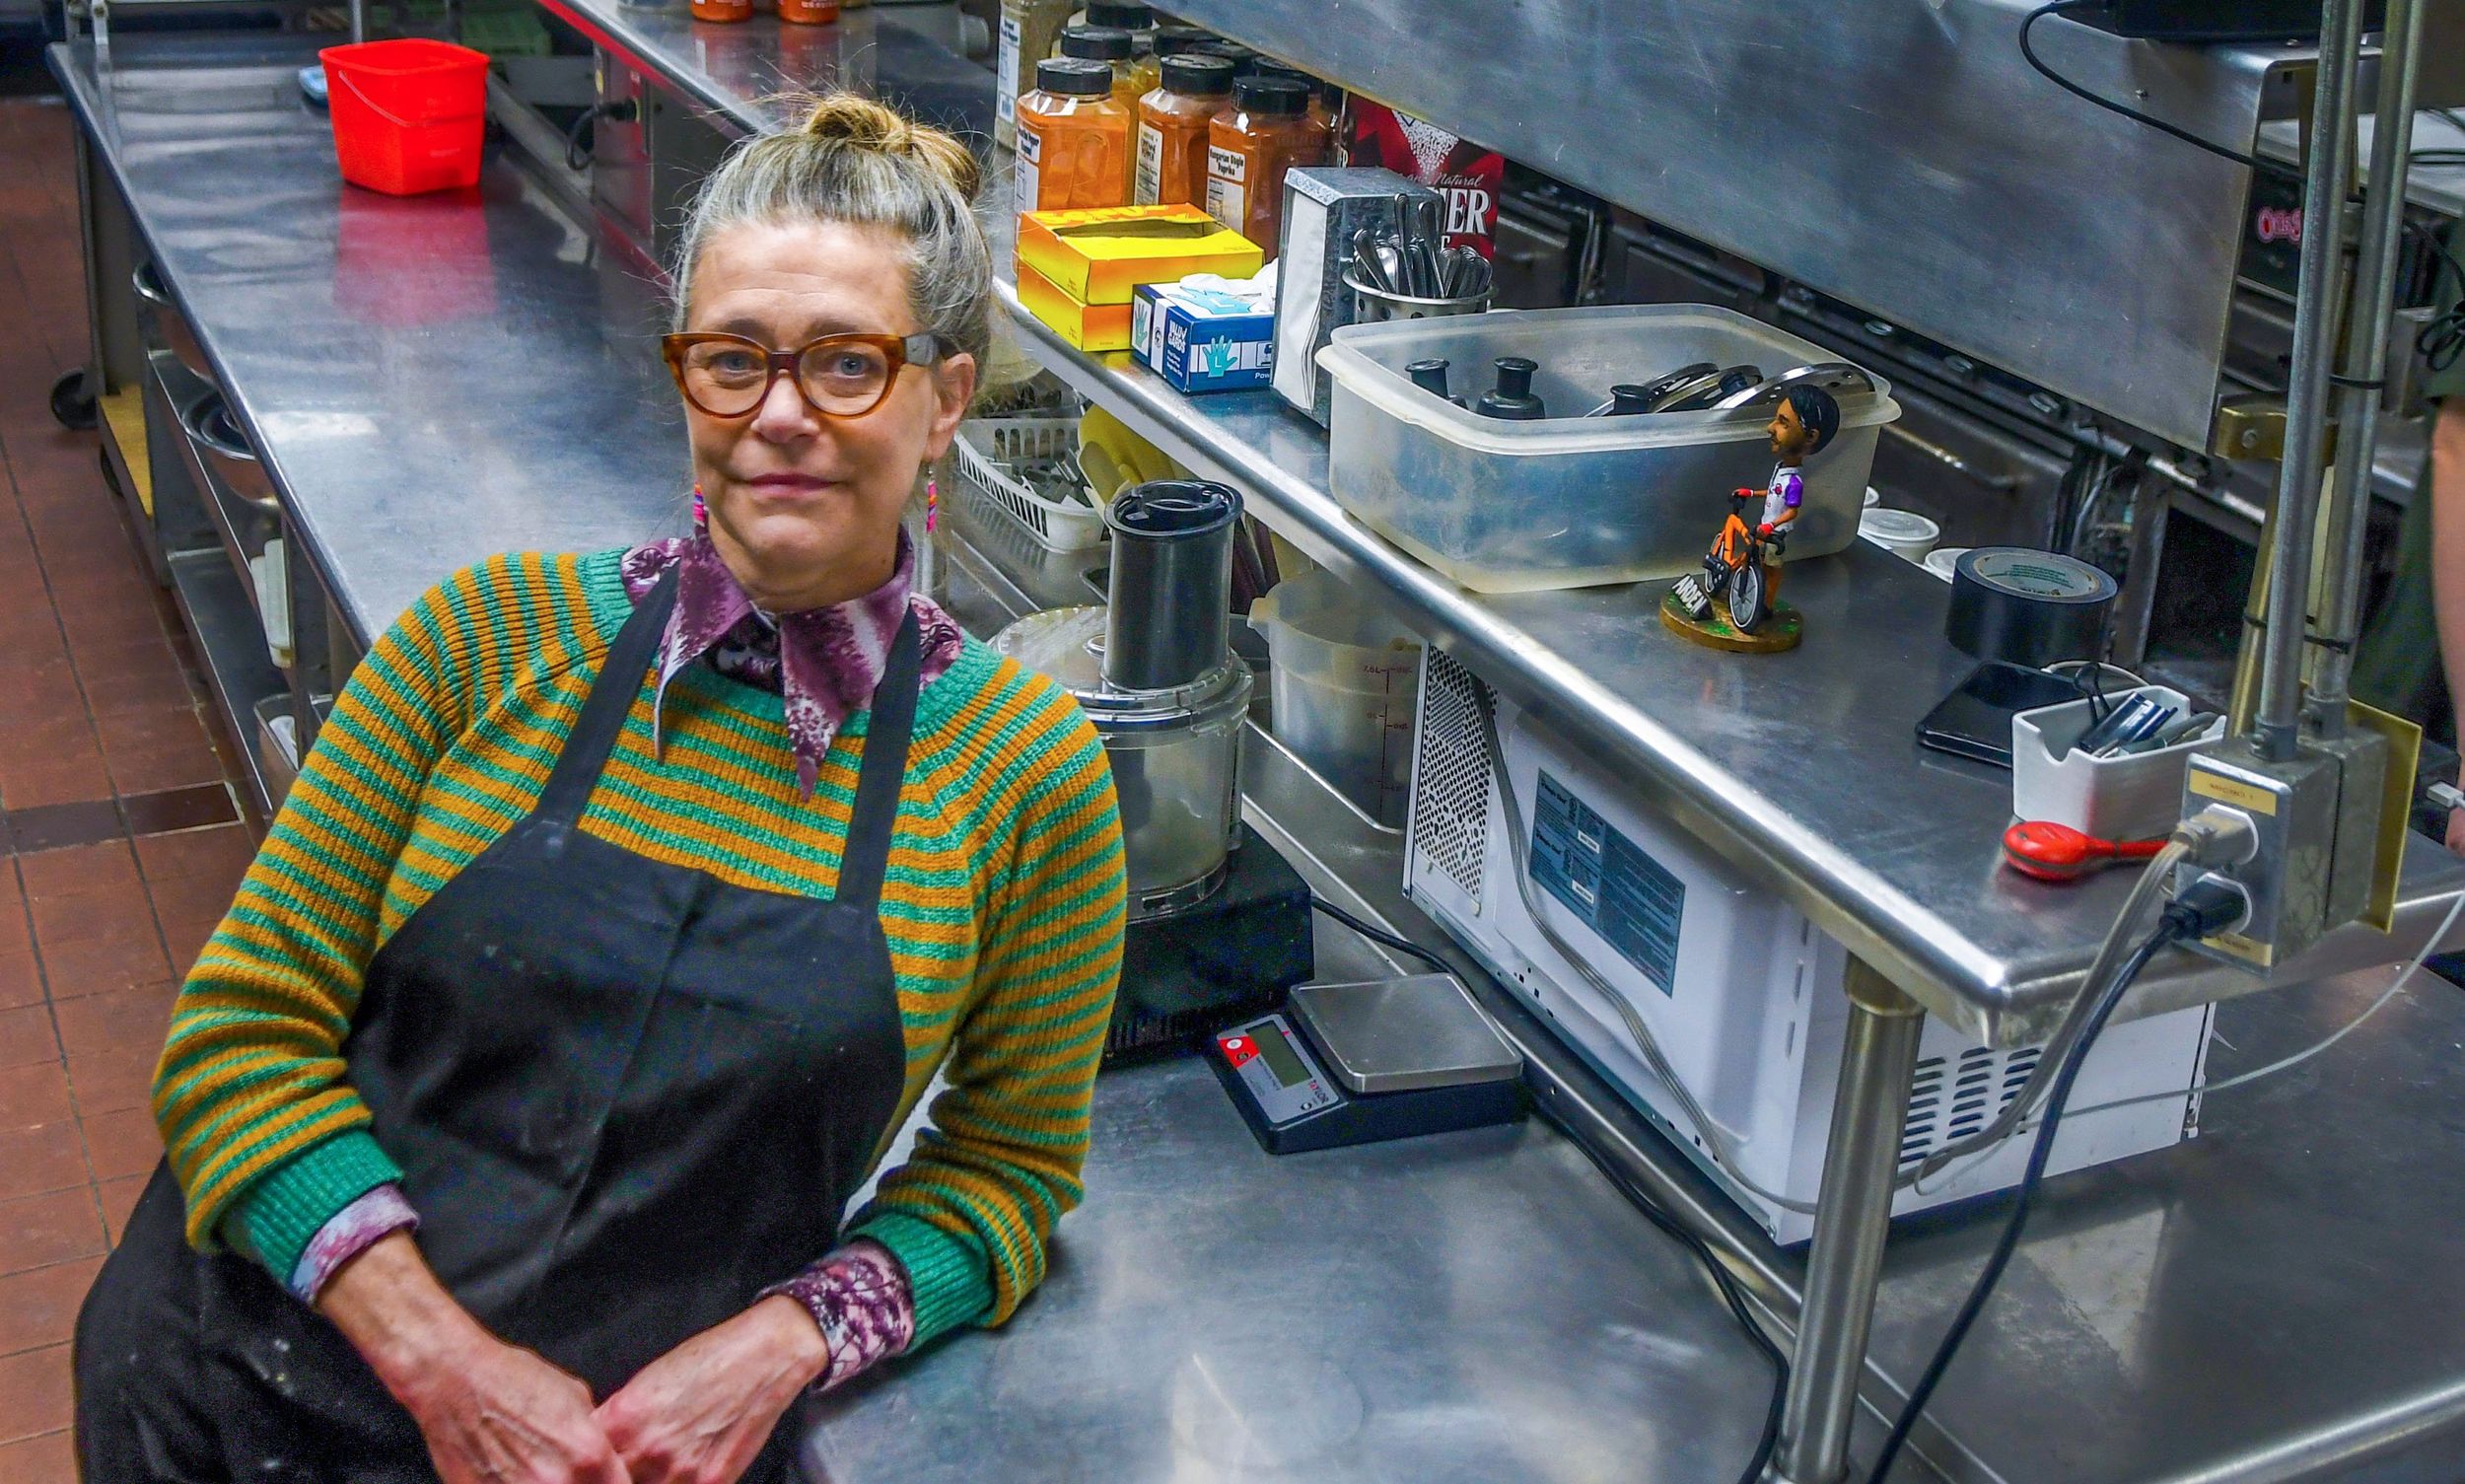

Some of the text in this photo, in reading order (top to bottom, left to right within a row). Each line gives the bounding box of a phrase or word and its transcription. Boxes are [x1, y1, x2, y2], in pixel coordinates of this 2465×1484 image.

[1434, 173, 1485, 188] Natural
[1214, 356, 1223, 368] L
[1672, 573, 1708, 614] ARDEN
